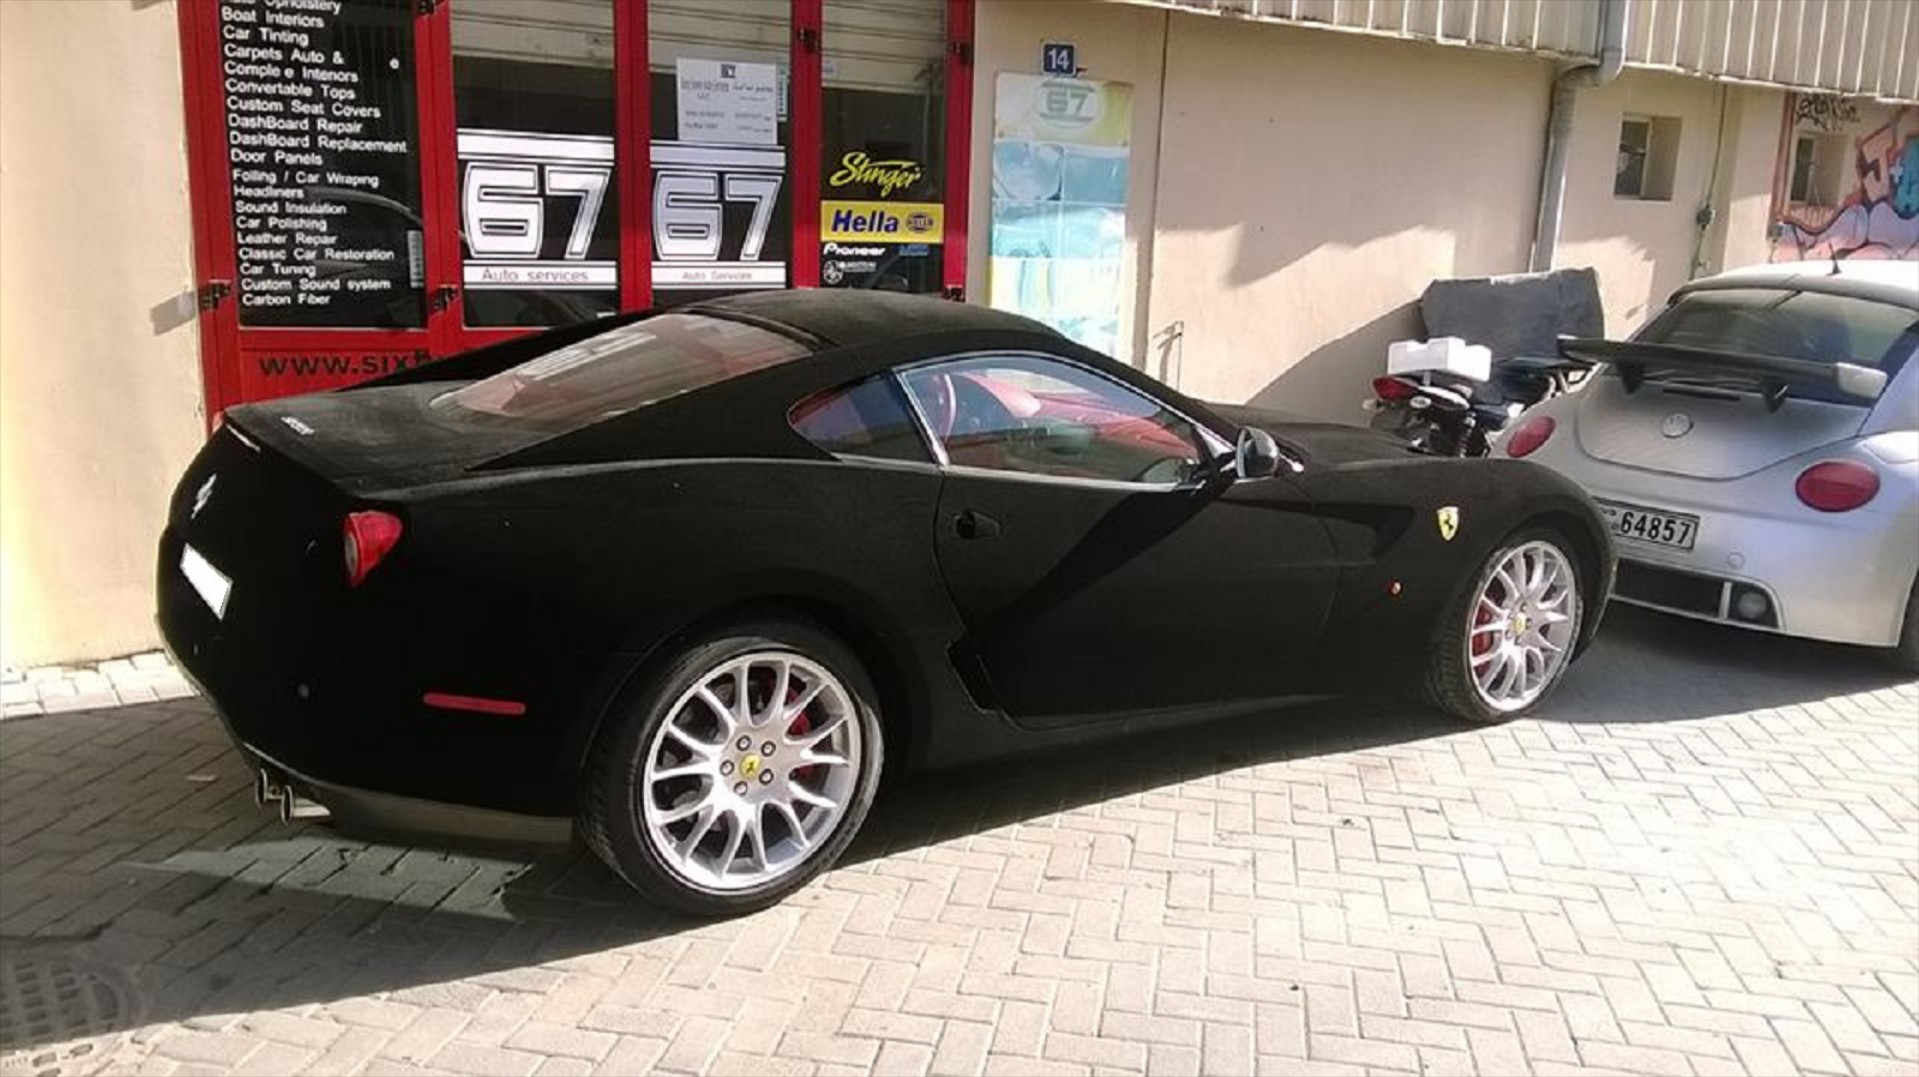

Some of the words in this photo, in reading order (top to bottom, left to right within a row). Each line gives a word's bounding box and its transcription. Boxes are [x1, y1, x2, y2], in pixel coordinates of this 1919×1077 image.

[222, 6, 257, 22] Boat
[265, 10, 324, 28] Interiors
[223, 24, 250, 39] Car
[259, 27, 309, 47] Tinting
[224, 43, 283, 61] Carpets
[290, 48, 325, 63] Auto
[332, 51, 344, 64] &
[1047, 48, 1071, 70] 14
[225, 78, 313, 97] Convertable
[320, 84, 356, 100] Tops
[227, 96, 283, 112] Custom
[291, 99, 325, 115] Seat
[331, 102, 381, 118] Covers
[1047, 90, 1088, 116] 67
[228, 113, 309, 131] DashBoard
[316, 117, 363, 134] Repair
[229, 131, 310, 148] DashBoard
[317, 135, 407, 153] Replacement
[230, 149, 267, 163] Door
[274, 151, 323, 166] Panels
[283, 170, 289, 183] /
[295, 171, 320, 184] Car
[326, 171, 379, 189] Wraping
[829, 151, 921, 197] Stinger
[233, 185, 304, 199] Headliners
[235, 200, 279, 214] Sound
[285, 201, 347, 215] Insulation
[462, 161, 612, 260] 67
[653, 170, 783, 261] 67
[236, 215, 261, 229] Car
[268, 216, 328, 232] Polishing
[831, 208, 899, 233] Hella
[237, 231, 287, 245] Leather
[295, 231, 338, 247] Repair
[824, 242, 886, 256] Pioneer
[238, 247, 287, 261] Classic
[293, 247, 317, 261] Car
[324, 247, 394, 261] Restoration
[240, 262, 264, 275] Car
[272, 262, 317, 278] Tuning
[481, 267, 519, 281] Auto
[527, 271, 589, 282] services
[682, 271, 706, 281] Auto
[241, 277, 292, 291] Custom
[299, 277, 341, 291] Sound
[347, 279, 392, 293] system
[242, 293, 291, 307] Carbon
[297, 293, 331, 305] Fiber
[259, 348, 432, 374] www.six
[1620, 511, 1692, 544] 64857
